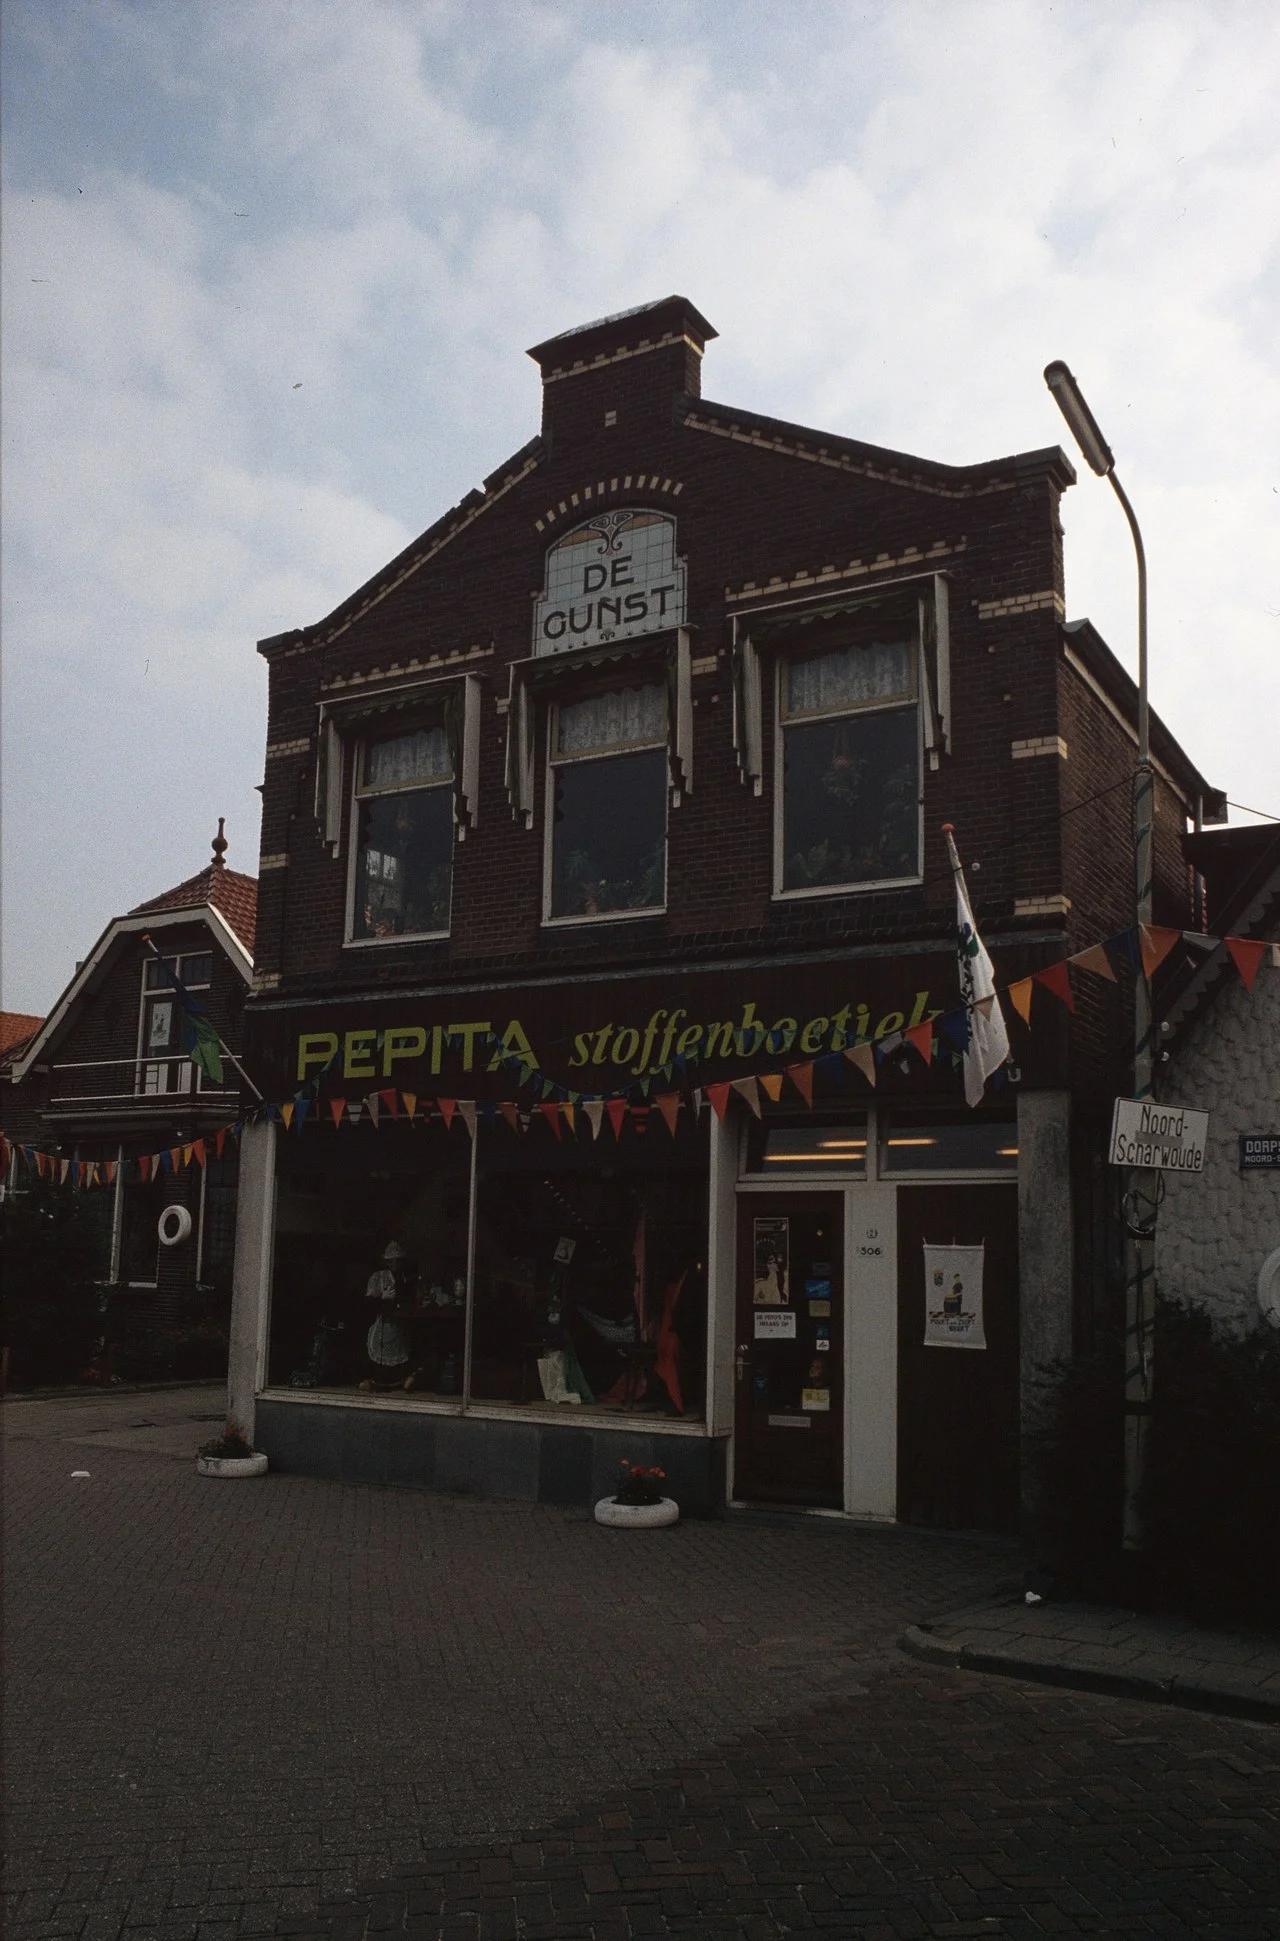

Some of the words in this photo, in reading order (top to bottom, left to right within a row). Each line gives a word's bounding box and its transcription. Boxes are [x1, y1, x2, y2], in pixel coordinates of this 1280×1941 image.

[583, 556, 635, 594] DE
[543, 584, 676, 640] GUNST
[297, 1019, 540, 1081] PEPITA
[568, 991, 944, 1076] stoffenboetiek
[1140, 1105, 1189, 1137] Noord-
